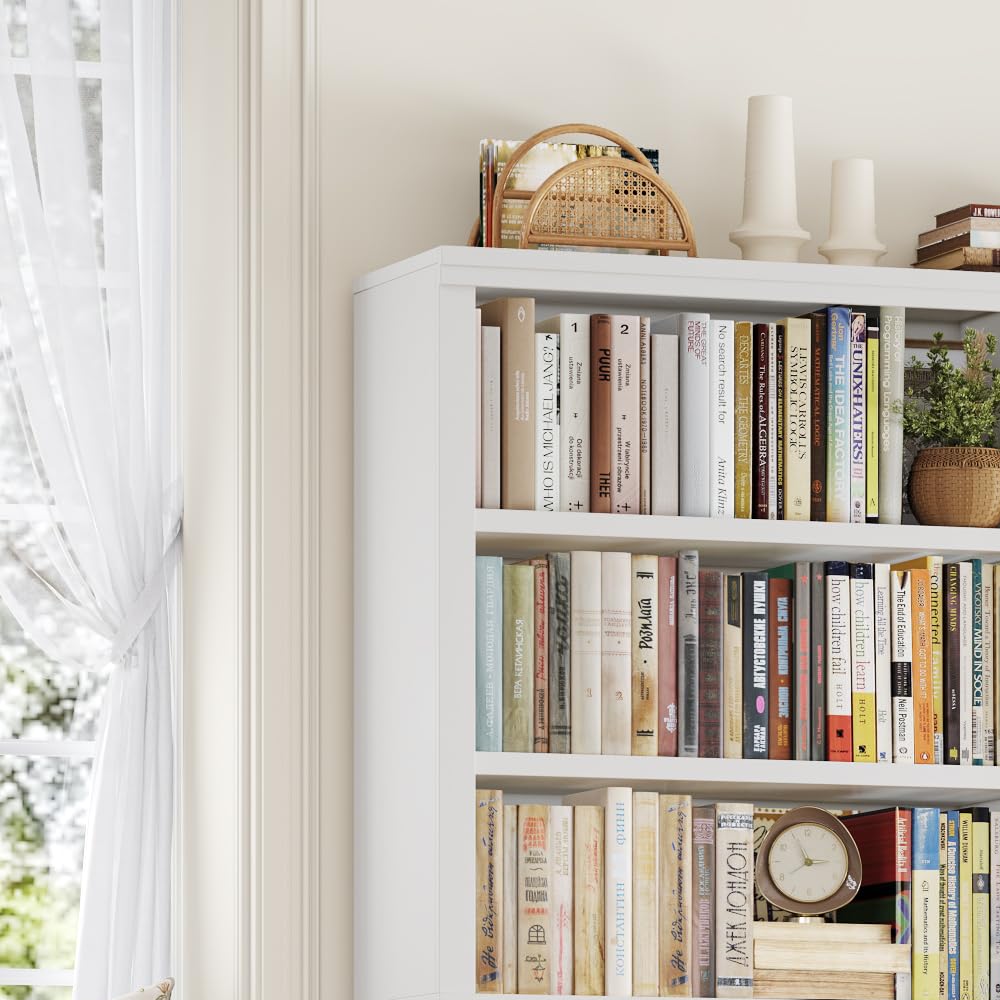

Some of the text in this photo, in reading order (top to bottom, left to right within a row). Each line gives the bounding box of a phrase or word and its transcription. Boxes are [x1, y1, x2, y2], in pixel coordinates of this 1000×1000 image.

[718, 325, 727, 424] No search result for
[758, 366, 767, 382] The
[758, 383, 767, 403] Rules
[799, 347, 808, 389] LEWIS
[543, 346, 554, 512] WHO IS MICHAEL JANG?
[599, 348, 610, 497] PUUR THEE
[758, 405, 767, 414] of
[758, 415, 767, 466] ALGEBRA
[753, 581, 766, 688] АВГУСТОВСКИЕ ПУШКИ
[854, 582, 871, 607] how
[854, 608, 871, 657] children
[513, 619, 524, 699] ВЕРА КЕТЛИНСКАЯ
[829, 578, 848, 709] how children fail HOLT
[854, 660, 871, 690] learn
[896, 590, 906, 741] The End of Education Neil Postman
[615, 802, 625, 977] КОНСТАНТИН ФИНН
[726, 842, 748, 967] ДЖЕК ЛОНДОН
